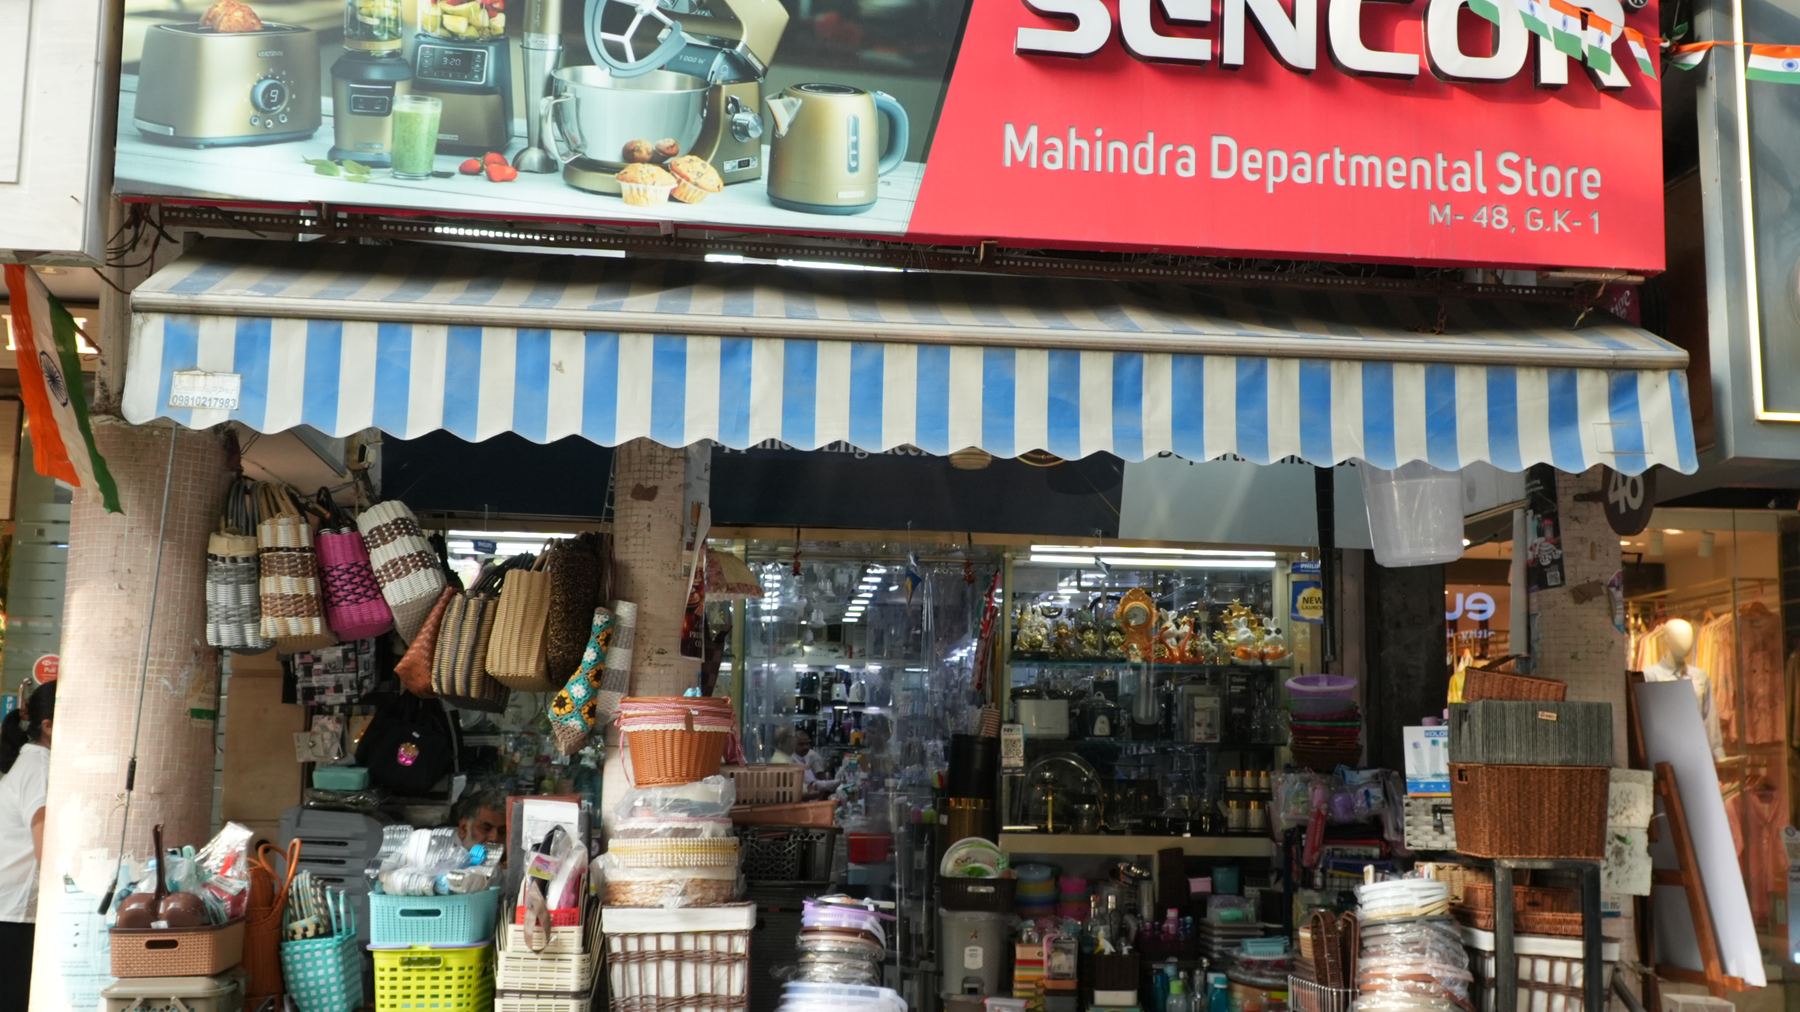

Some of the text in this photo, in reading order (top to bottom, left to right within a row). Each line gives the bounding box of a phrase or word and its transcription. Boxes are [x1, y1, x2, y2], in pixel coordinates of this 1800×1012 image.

[1016, 0, 1631, 88] SENCOR
[1003, 121, 1601, 200] Mahindra Departmental Store
